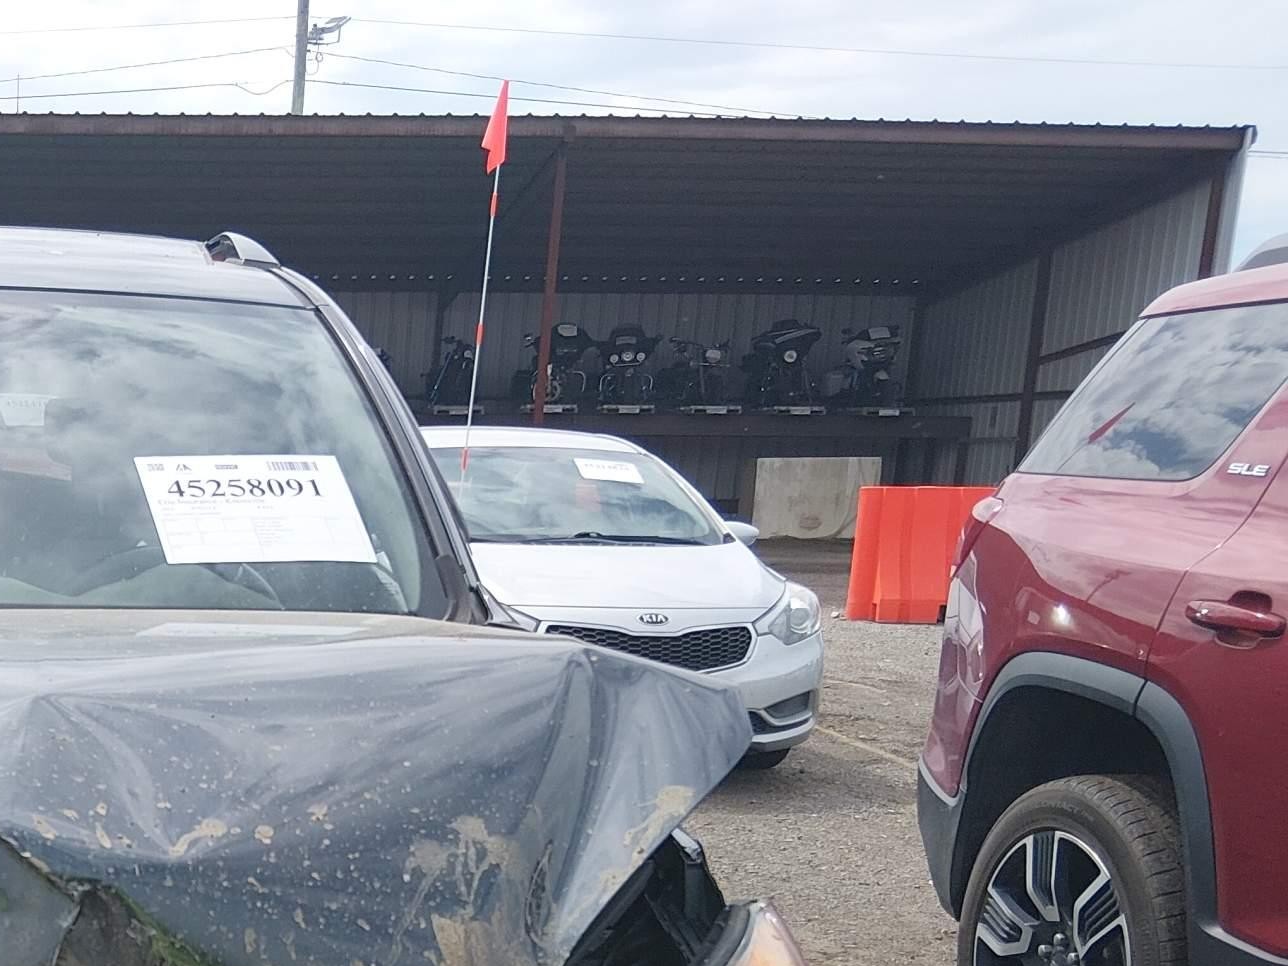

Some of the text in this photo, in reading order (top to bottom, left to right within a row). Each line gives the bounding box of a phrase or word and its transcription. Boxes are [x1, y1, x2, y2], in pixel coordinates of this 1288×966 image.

[1227, 462, 1270, 476] SLE
[168, 479, 321, 497] 45258091
[642, 614, 666, 622] KIA
